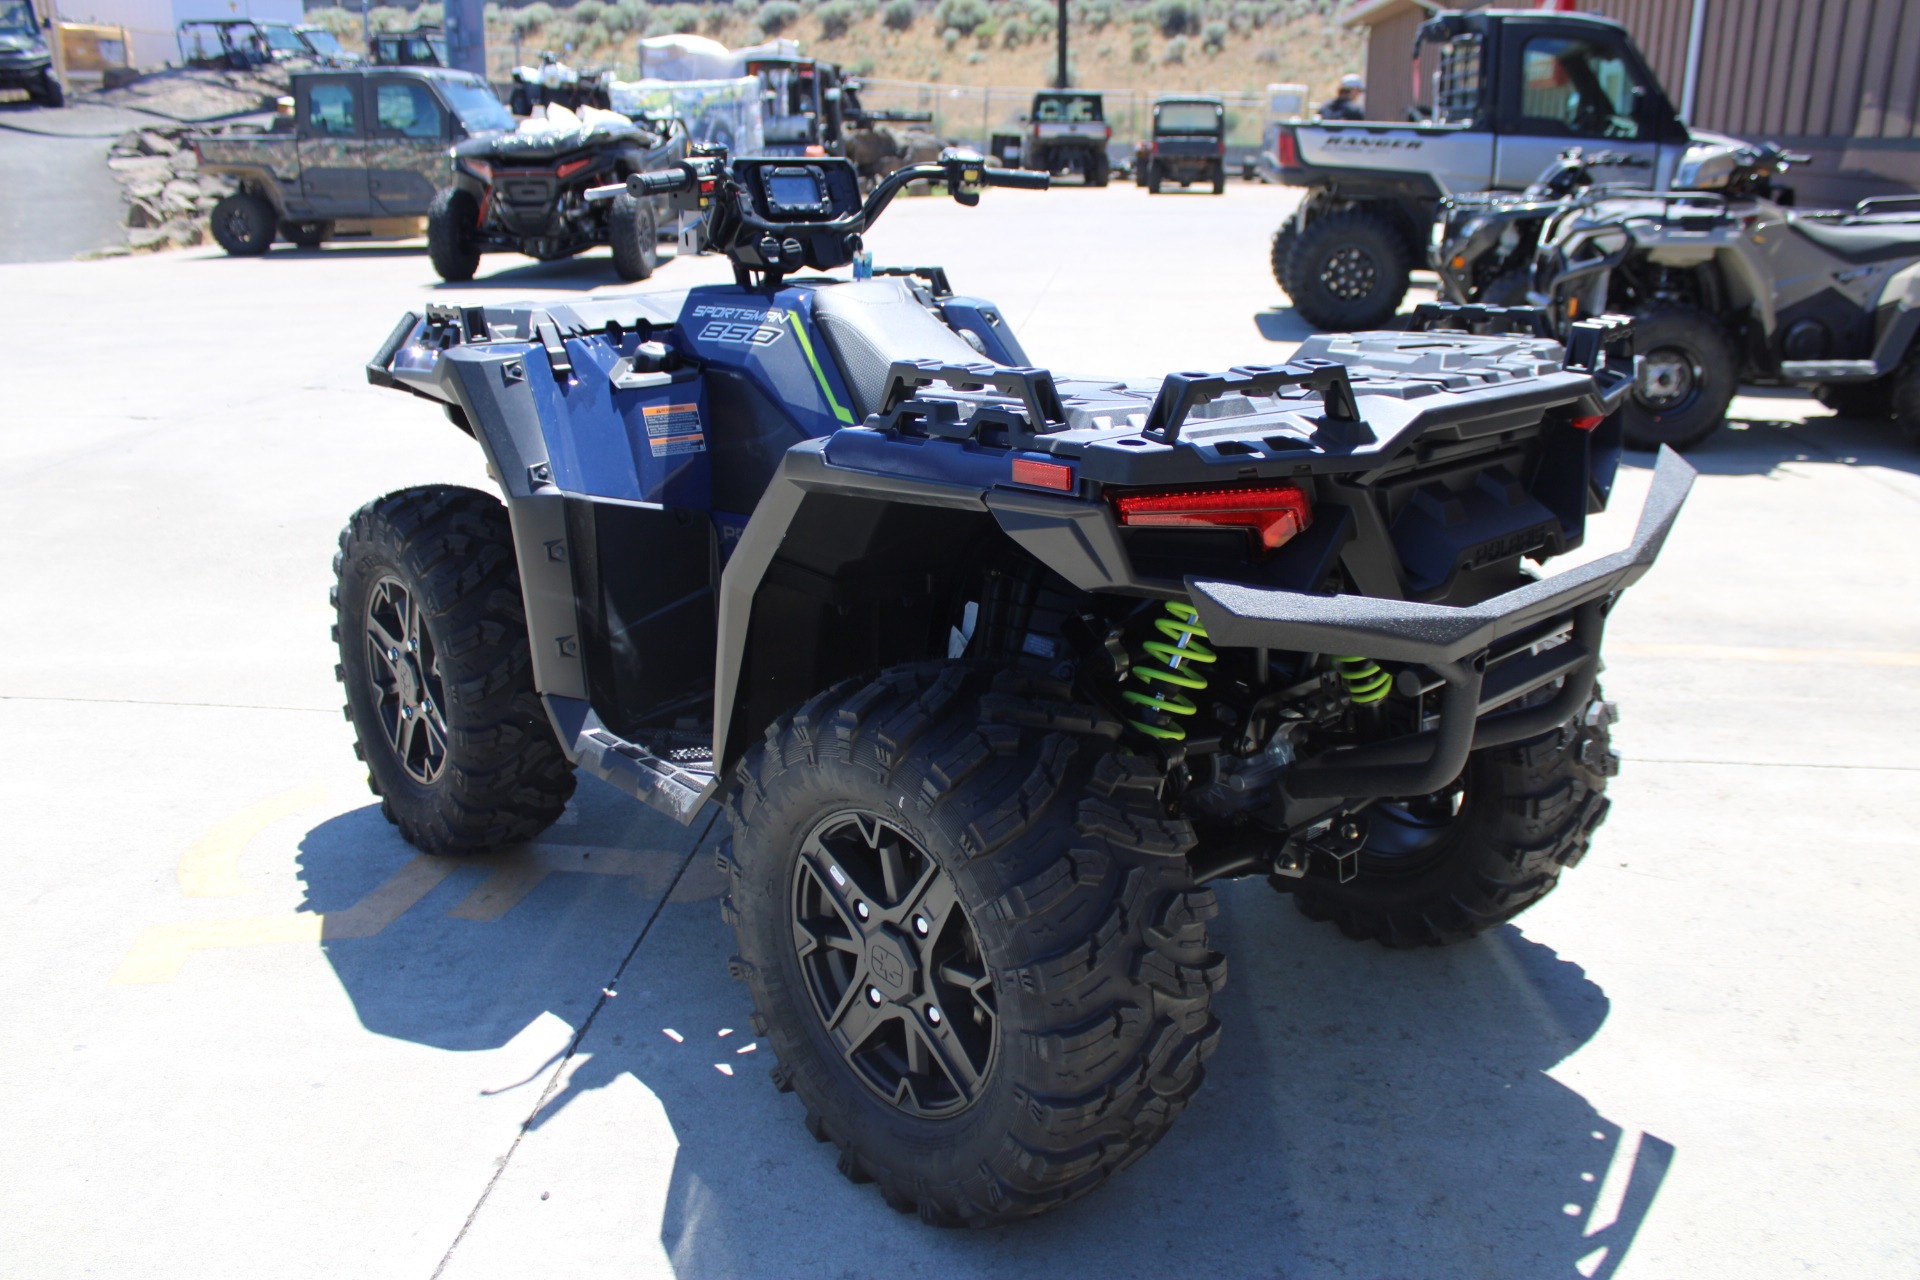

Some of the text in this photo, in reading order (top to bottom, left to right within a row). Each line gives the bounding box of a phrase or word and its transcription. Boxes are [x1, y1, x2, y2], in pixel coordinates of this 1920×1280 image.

[1326, 136, 1424, 150] RANGER
[691, 304, 790, 325] SPORTSMAN
[697, 321, 785, 347] 850
[1474, 523, 1546, 568] POLARIS
